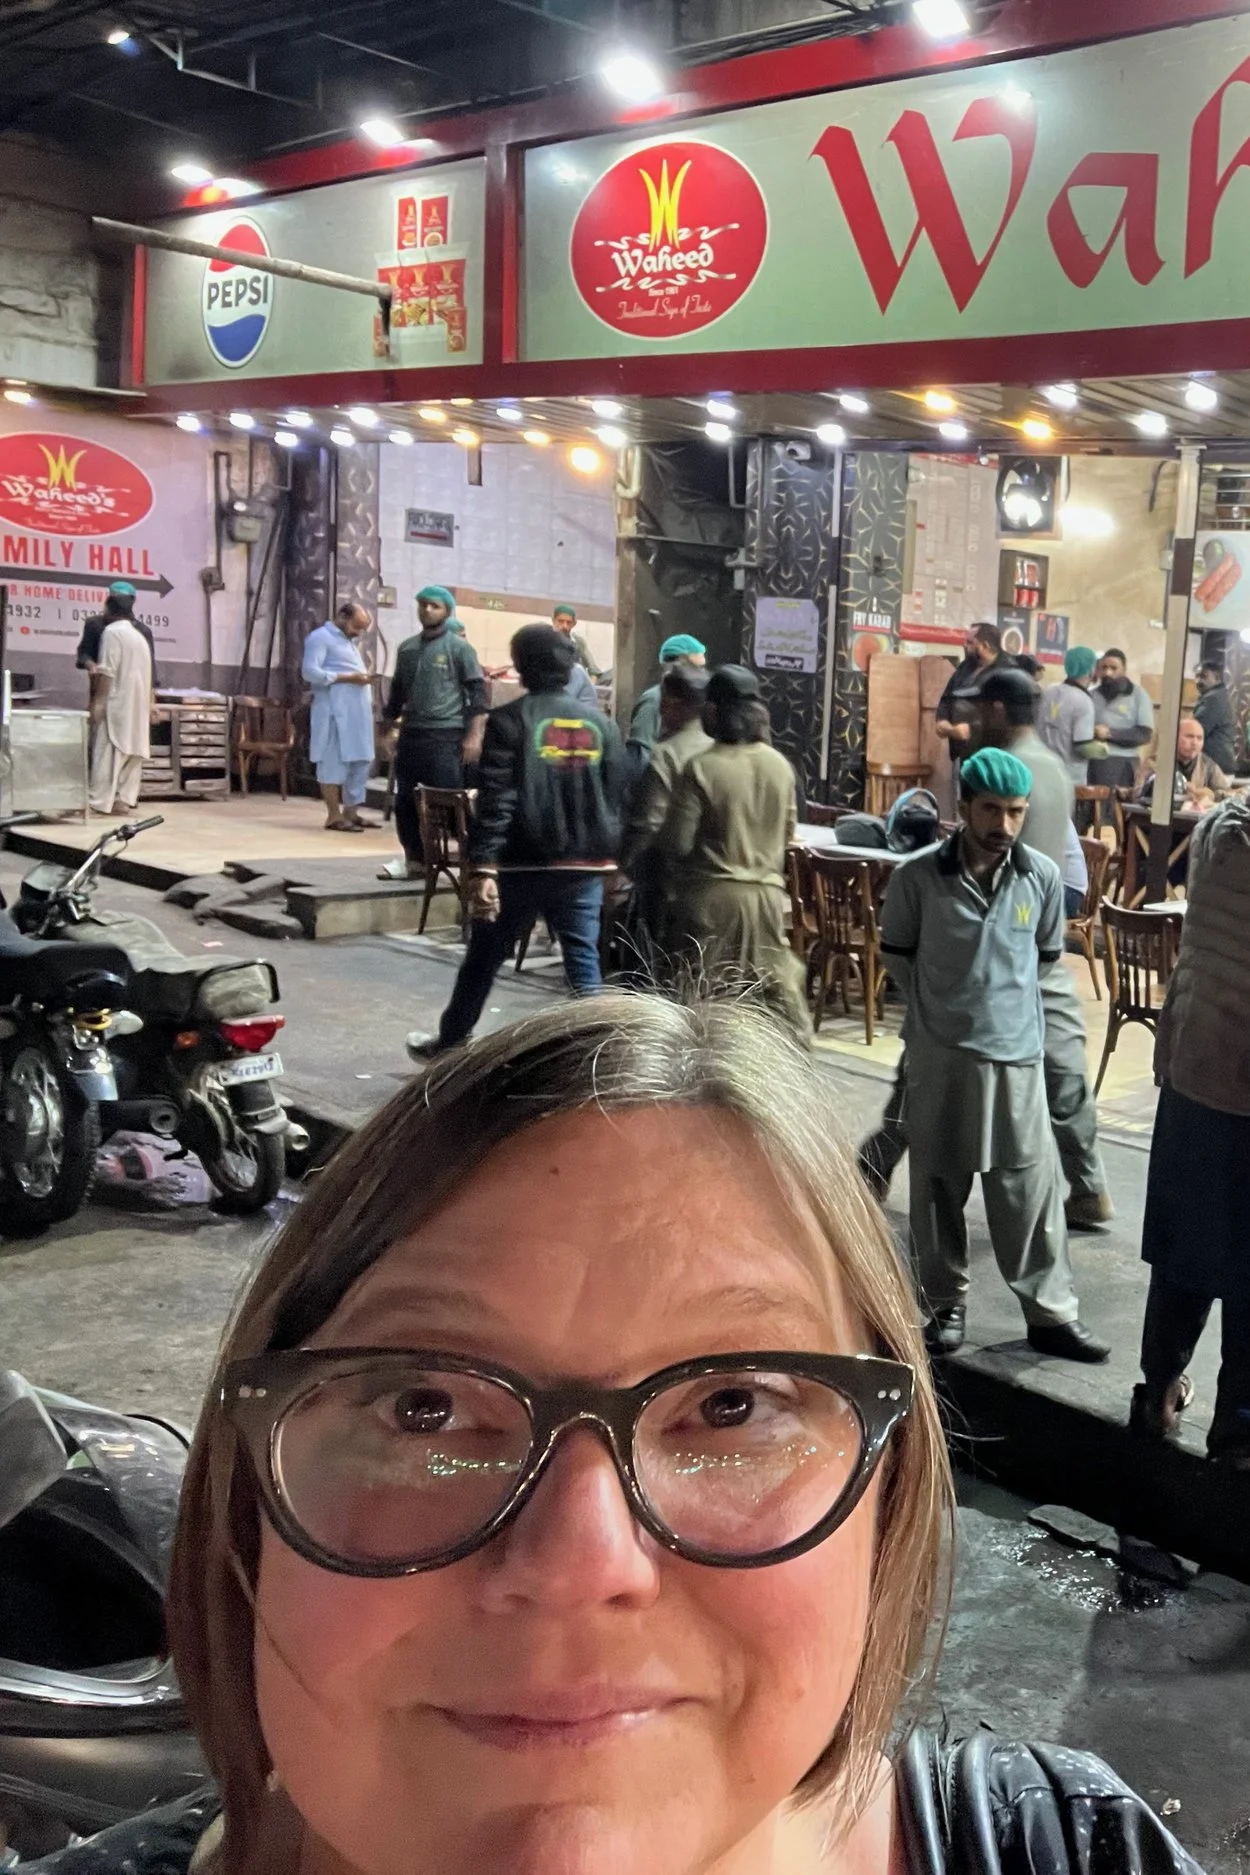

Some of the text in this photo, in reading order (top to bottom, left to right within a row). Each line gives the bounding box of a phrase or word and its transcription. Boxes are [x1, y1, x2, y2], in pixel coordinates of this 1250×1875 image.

[611, 243, 714, 277] Waheed
[207, 275, 268, 310] PEPSI
[1, 480, 116, 508] Waheed's
[3, 535, 155, 576] MILY HALL
[24, 585, 61, 600] HOME
